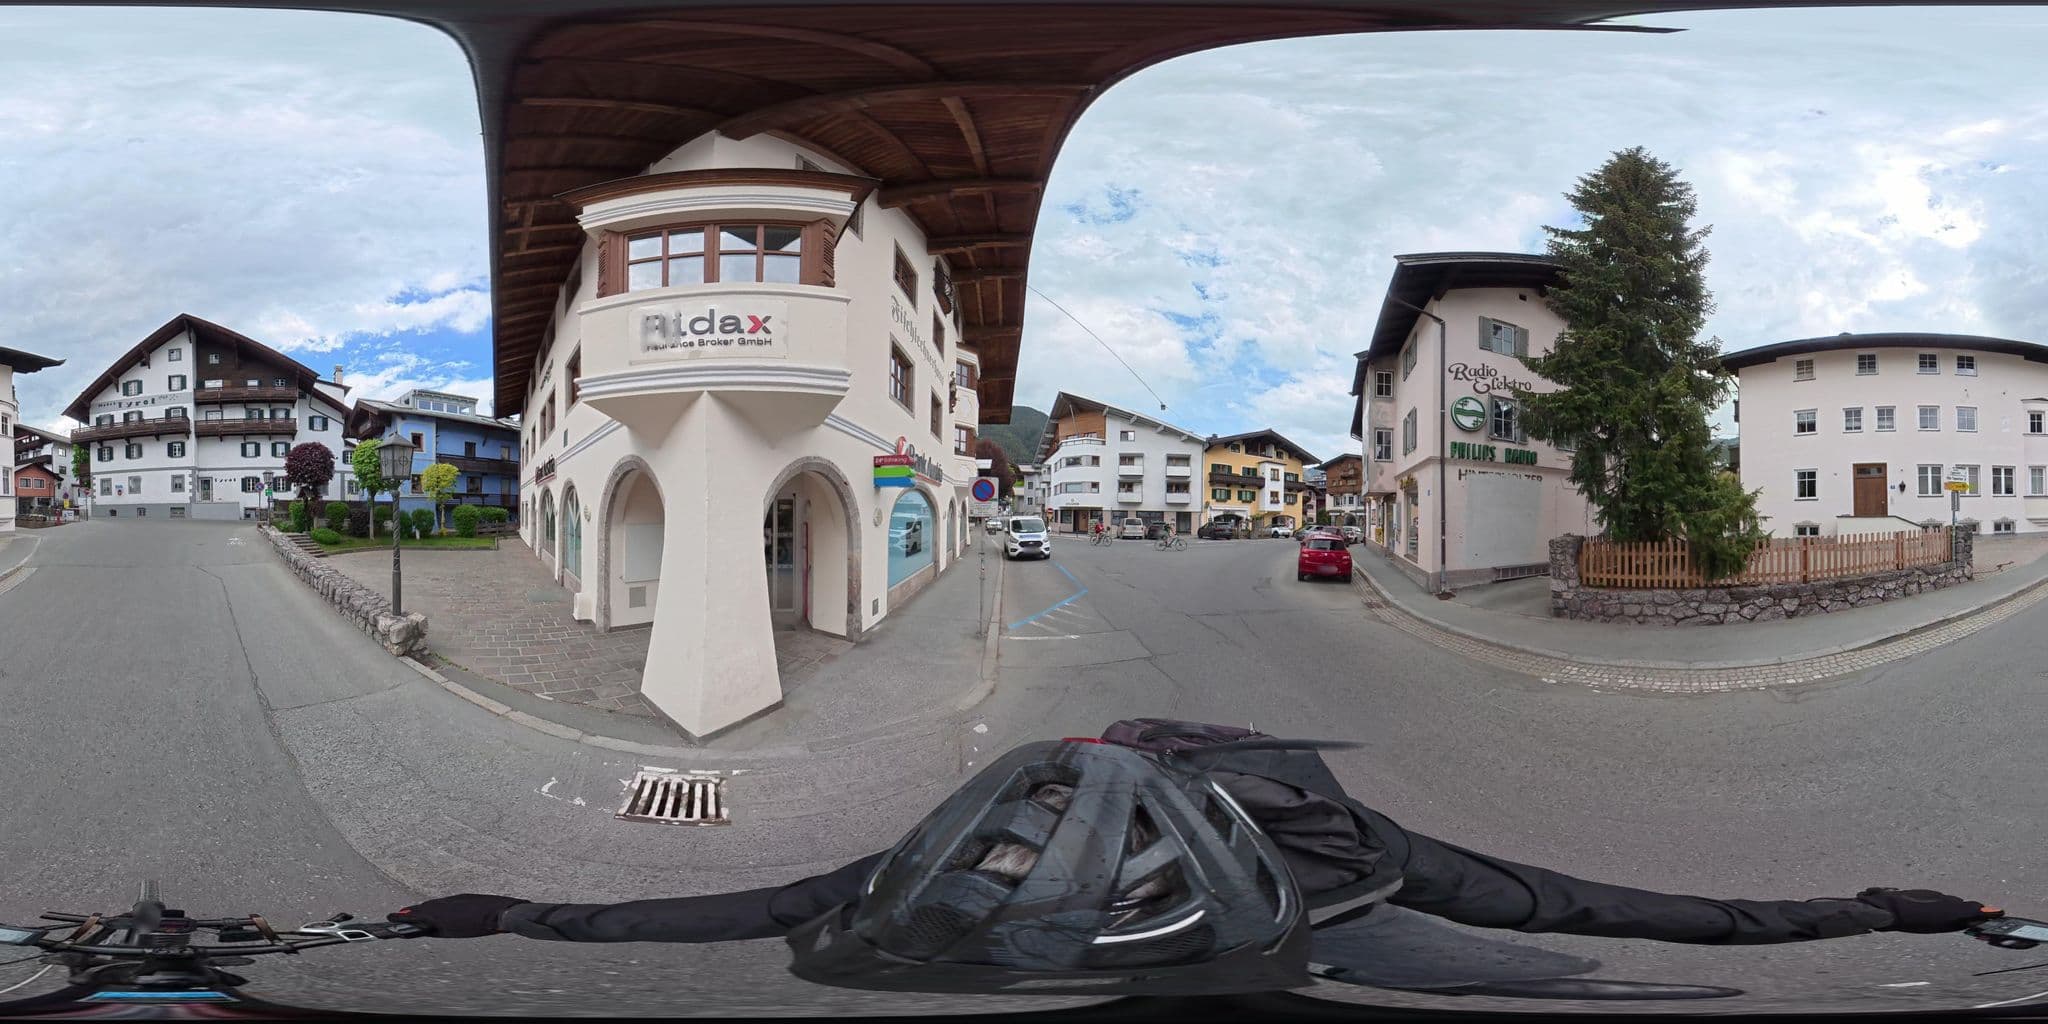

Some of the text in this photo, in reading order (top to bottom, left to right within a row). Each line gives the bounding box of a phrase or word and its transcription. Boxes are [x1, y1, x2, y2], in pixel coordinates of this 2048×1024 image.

[698, 337, 734, 347] Broker
[738, 336, 772, 346] GmbH
[1448, 362, 1498, 381] Radio
[1473, 376, 1532, 394] Elektro
[1450, 441, 1538, 465] PHILIPS RADIO
